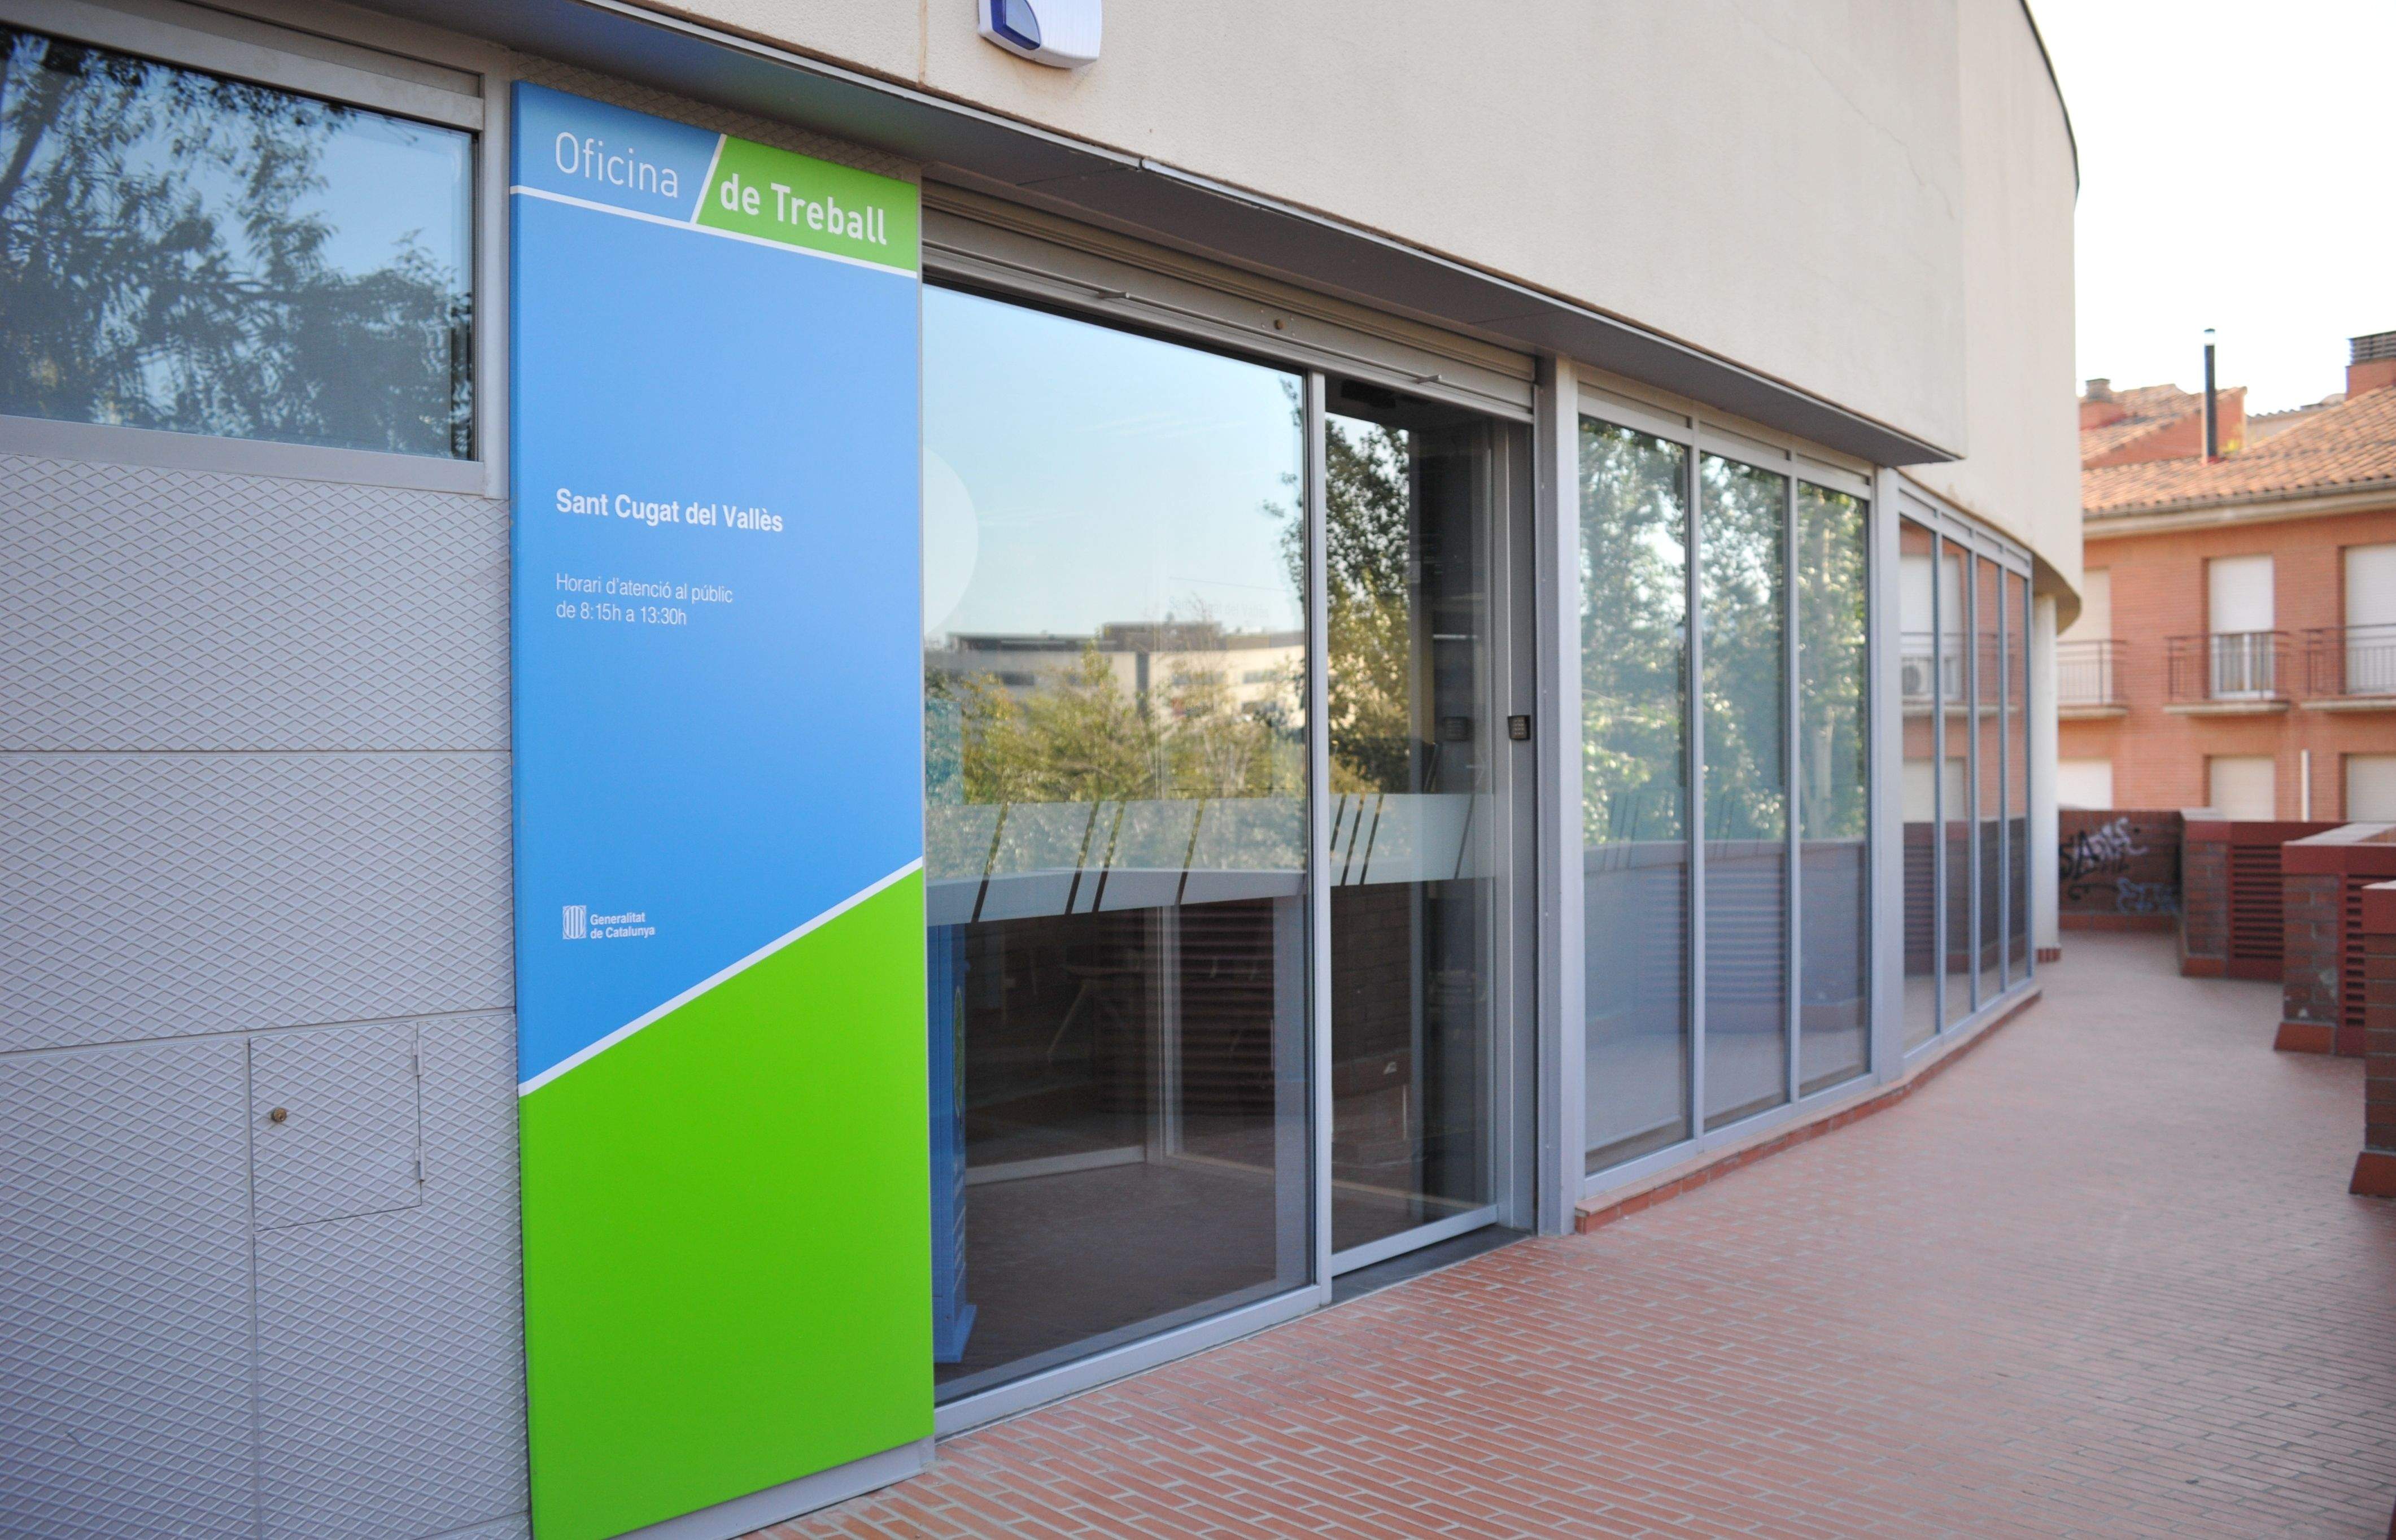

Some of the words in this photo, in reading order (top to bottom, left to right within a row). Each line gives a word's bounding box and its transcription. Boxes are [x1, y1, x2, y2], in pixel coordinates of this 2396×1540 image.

[555, 132, 678, 198] Oficina
[720, 173, 761, 216] de
[770, 182, 887, 246] Treball
[556, 487, 608, 516] Sant
[614, 494, 679, 526] Cugat
[685, 502, 716, 526] del
[722, 504, 783, 533] Vallès
[556, 573, 602, 593] Horari
[605, 577, 671, 599] d'atenció
[675, 583, 688, 600] al
[691, 584, 734, 604] públic
[556, 600, 577, 619] de
[580, 602, 622, 621] 8:15h
[625, 608, 635, 623] a
[640, 606, 687, 626] 13:30h
[590, 911, 646, 926] Generalitat
[590, 928, 603, 939] de
[605, 926, 656, 939] Catalunya
